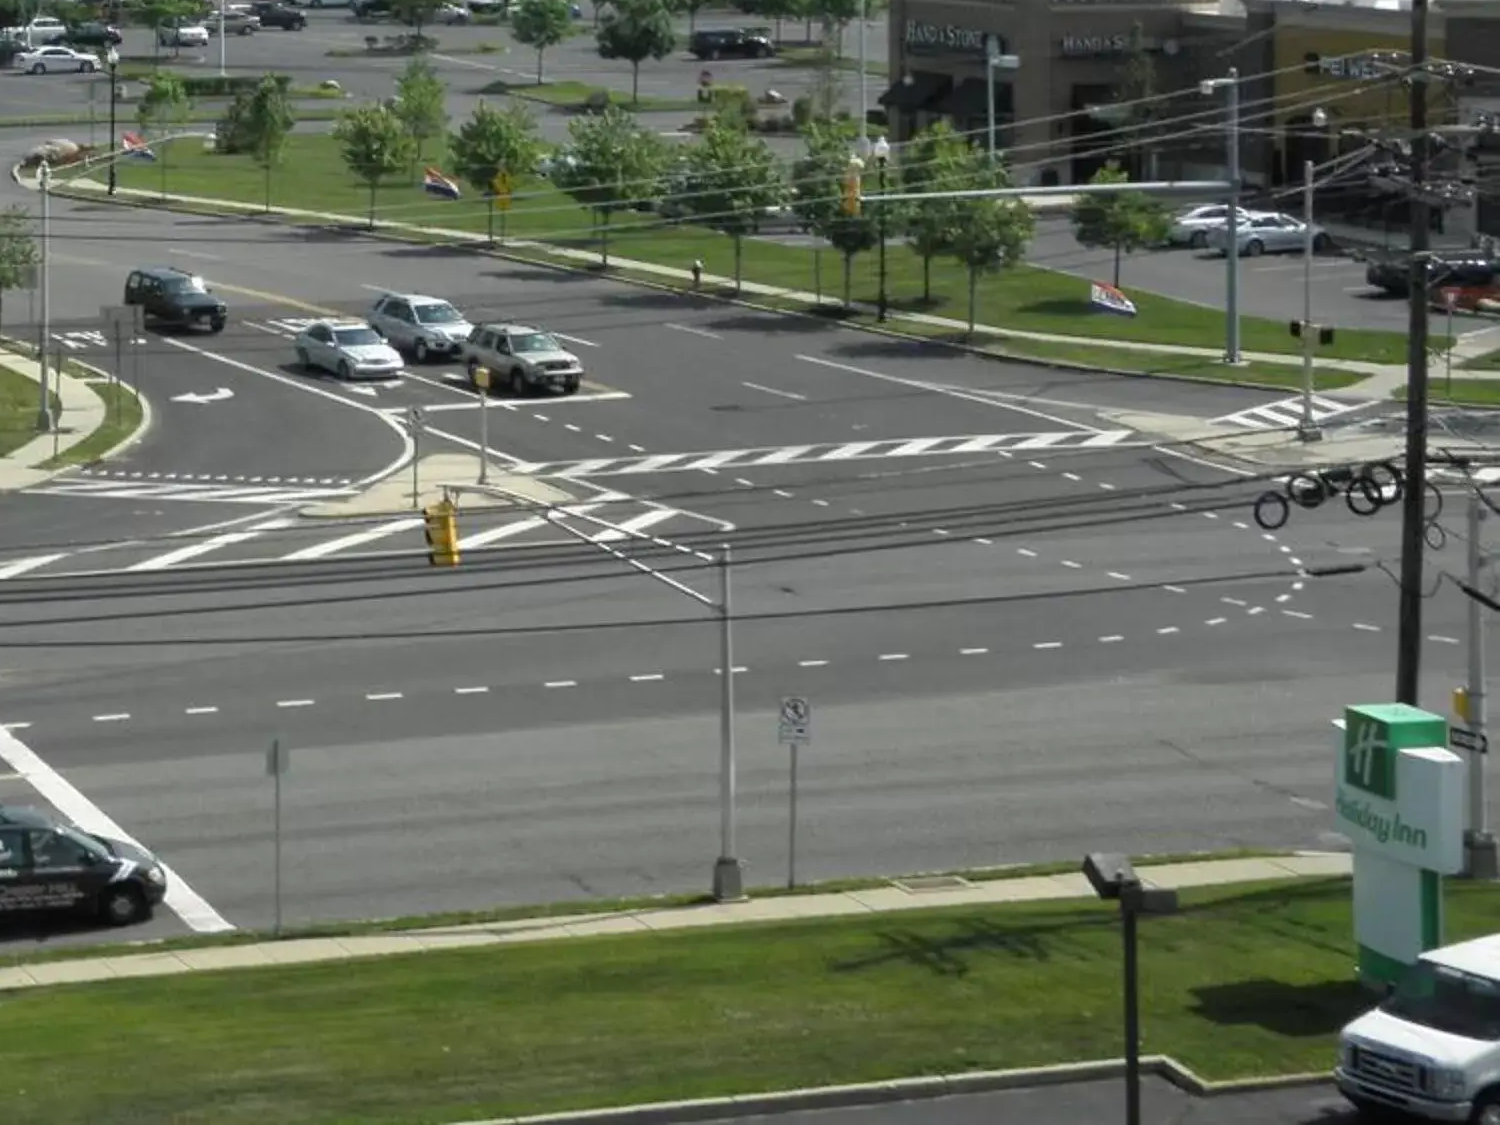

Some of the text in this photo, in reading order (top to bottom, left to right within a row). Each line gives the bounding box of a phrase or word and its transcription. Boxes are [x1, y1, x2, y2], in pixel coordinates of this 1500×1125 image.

[905, 19, 937, 44] HAND
[947, 24, 984, 49] STONE
[1393, 812, 1427, 851] Inn
